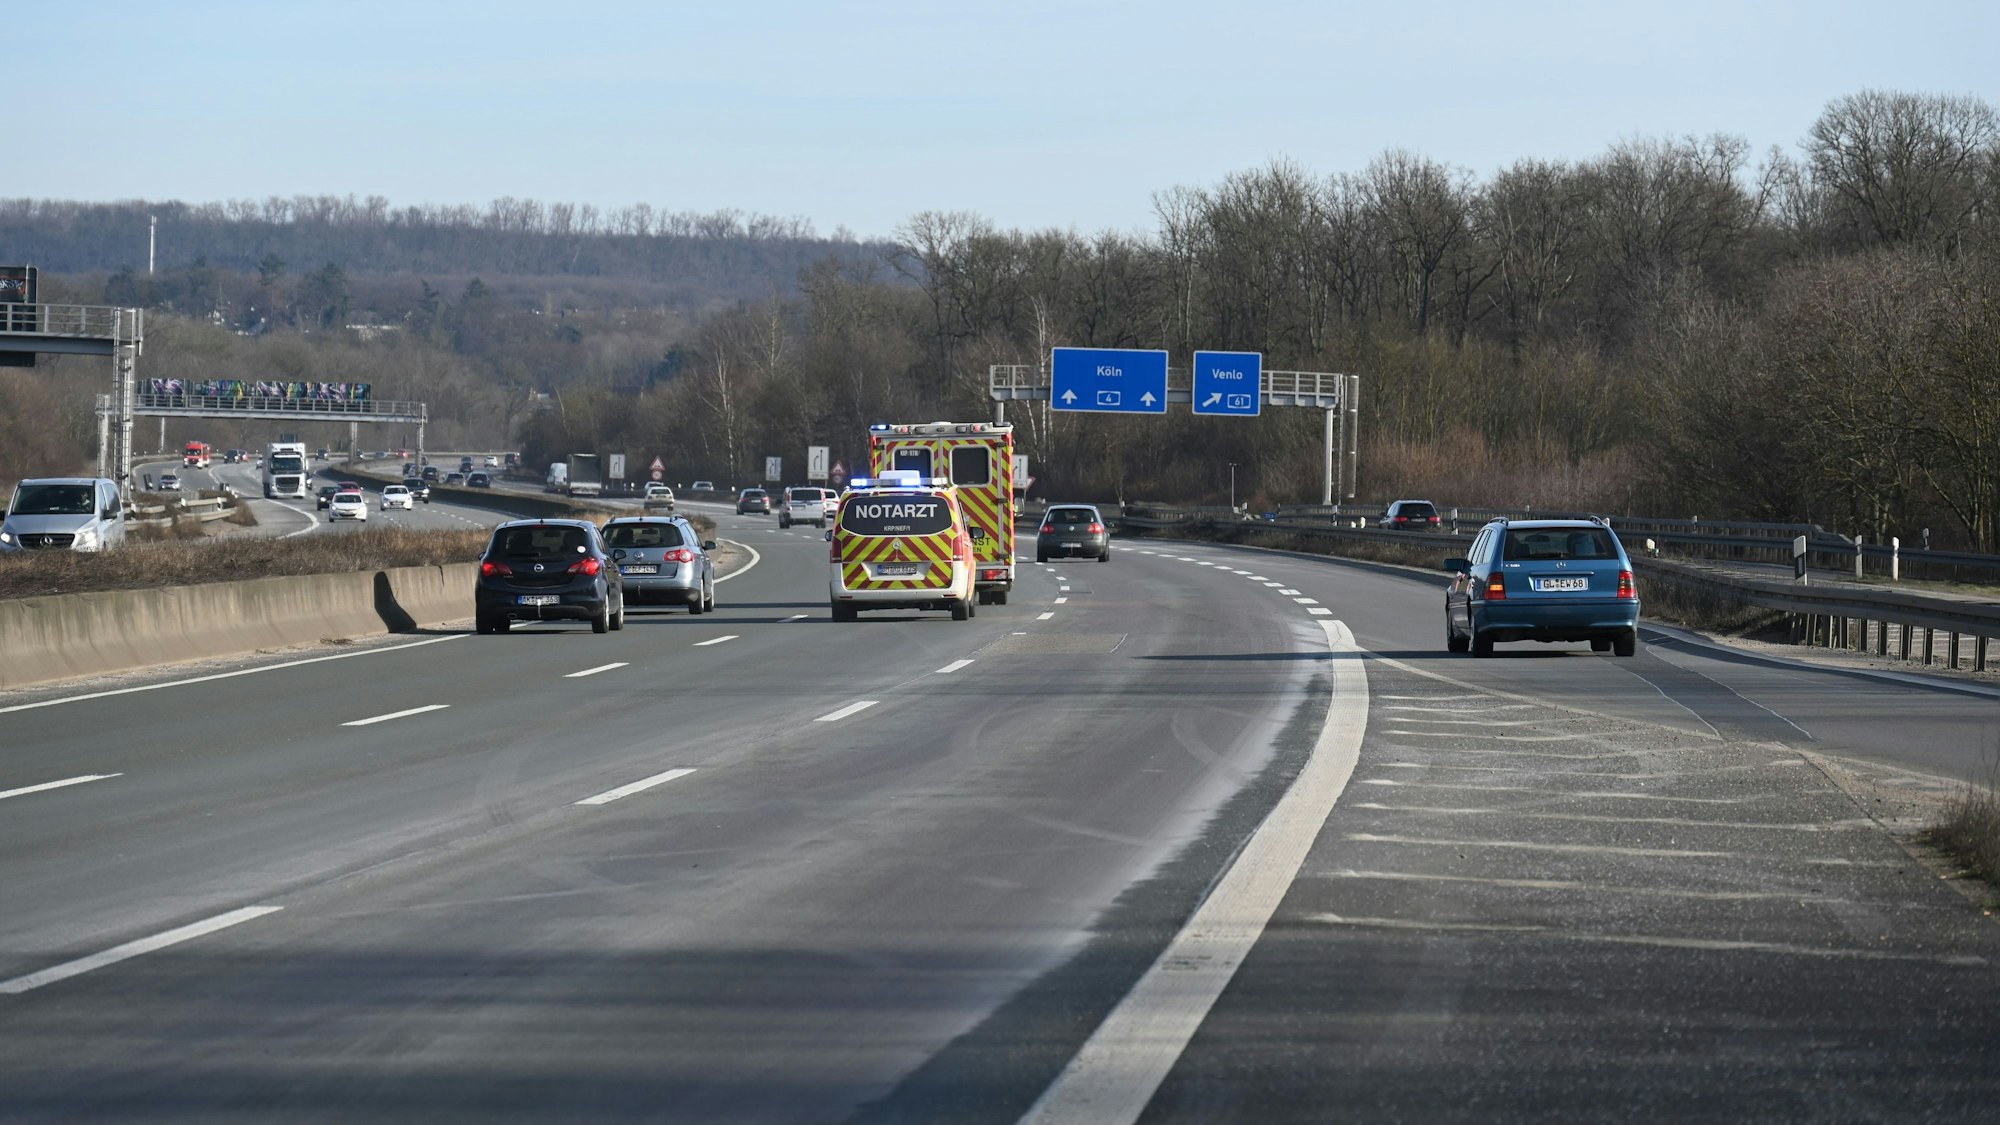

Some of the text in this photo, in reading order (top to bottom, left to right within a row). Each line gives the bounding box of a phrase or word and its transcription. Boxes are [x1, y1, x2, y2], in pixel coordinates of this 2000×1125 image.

[1097, 365, 1122, 377] Köln
[1212, 368, 1243, 380] Venlo
[1105, 393, 1112, 403] 4
[1234, 396, 1244, 406] 61
[855, 503, 938, 519] NOTARZT
[972, 537, 991, 546] NST
